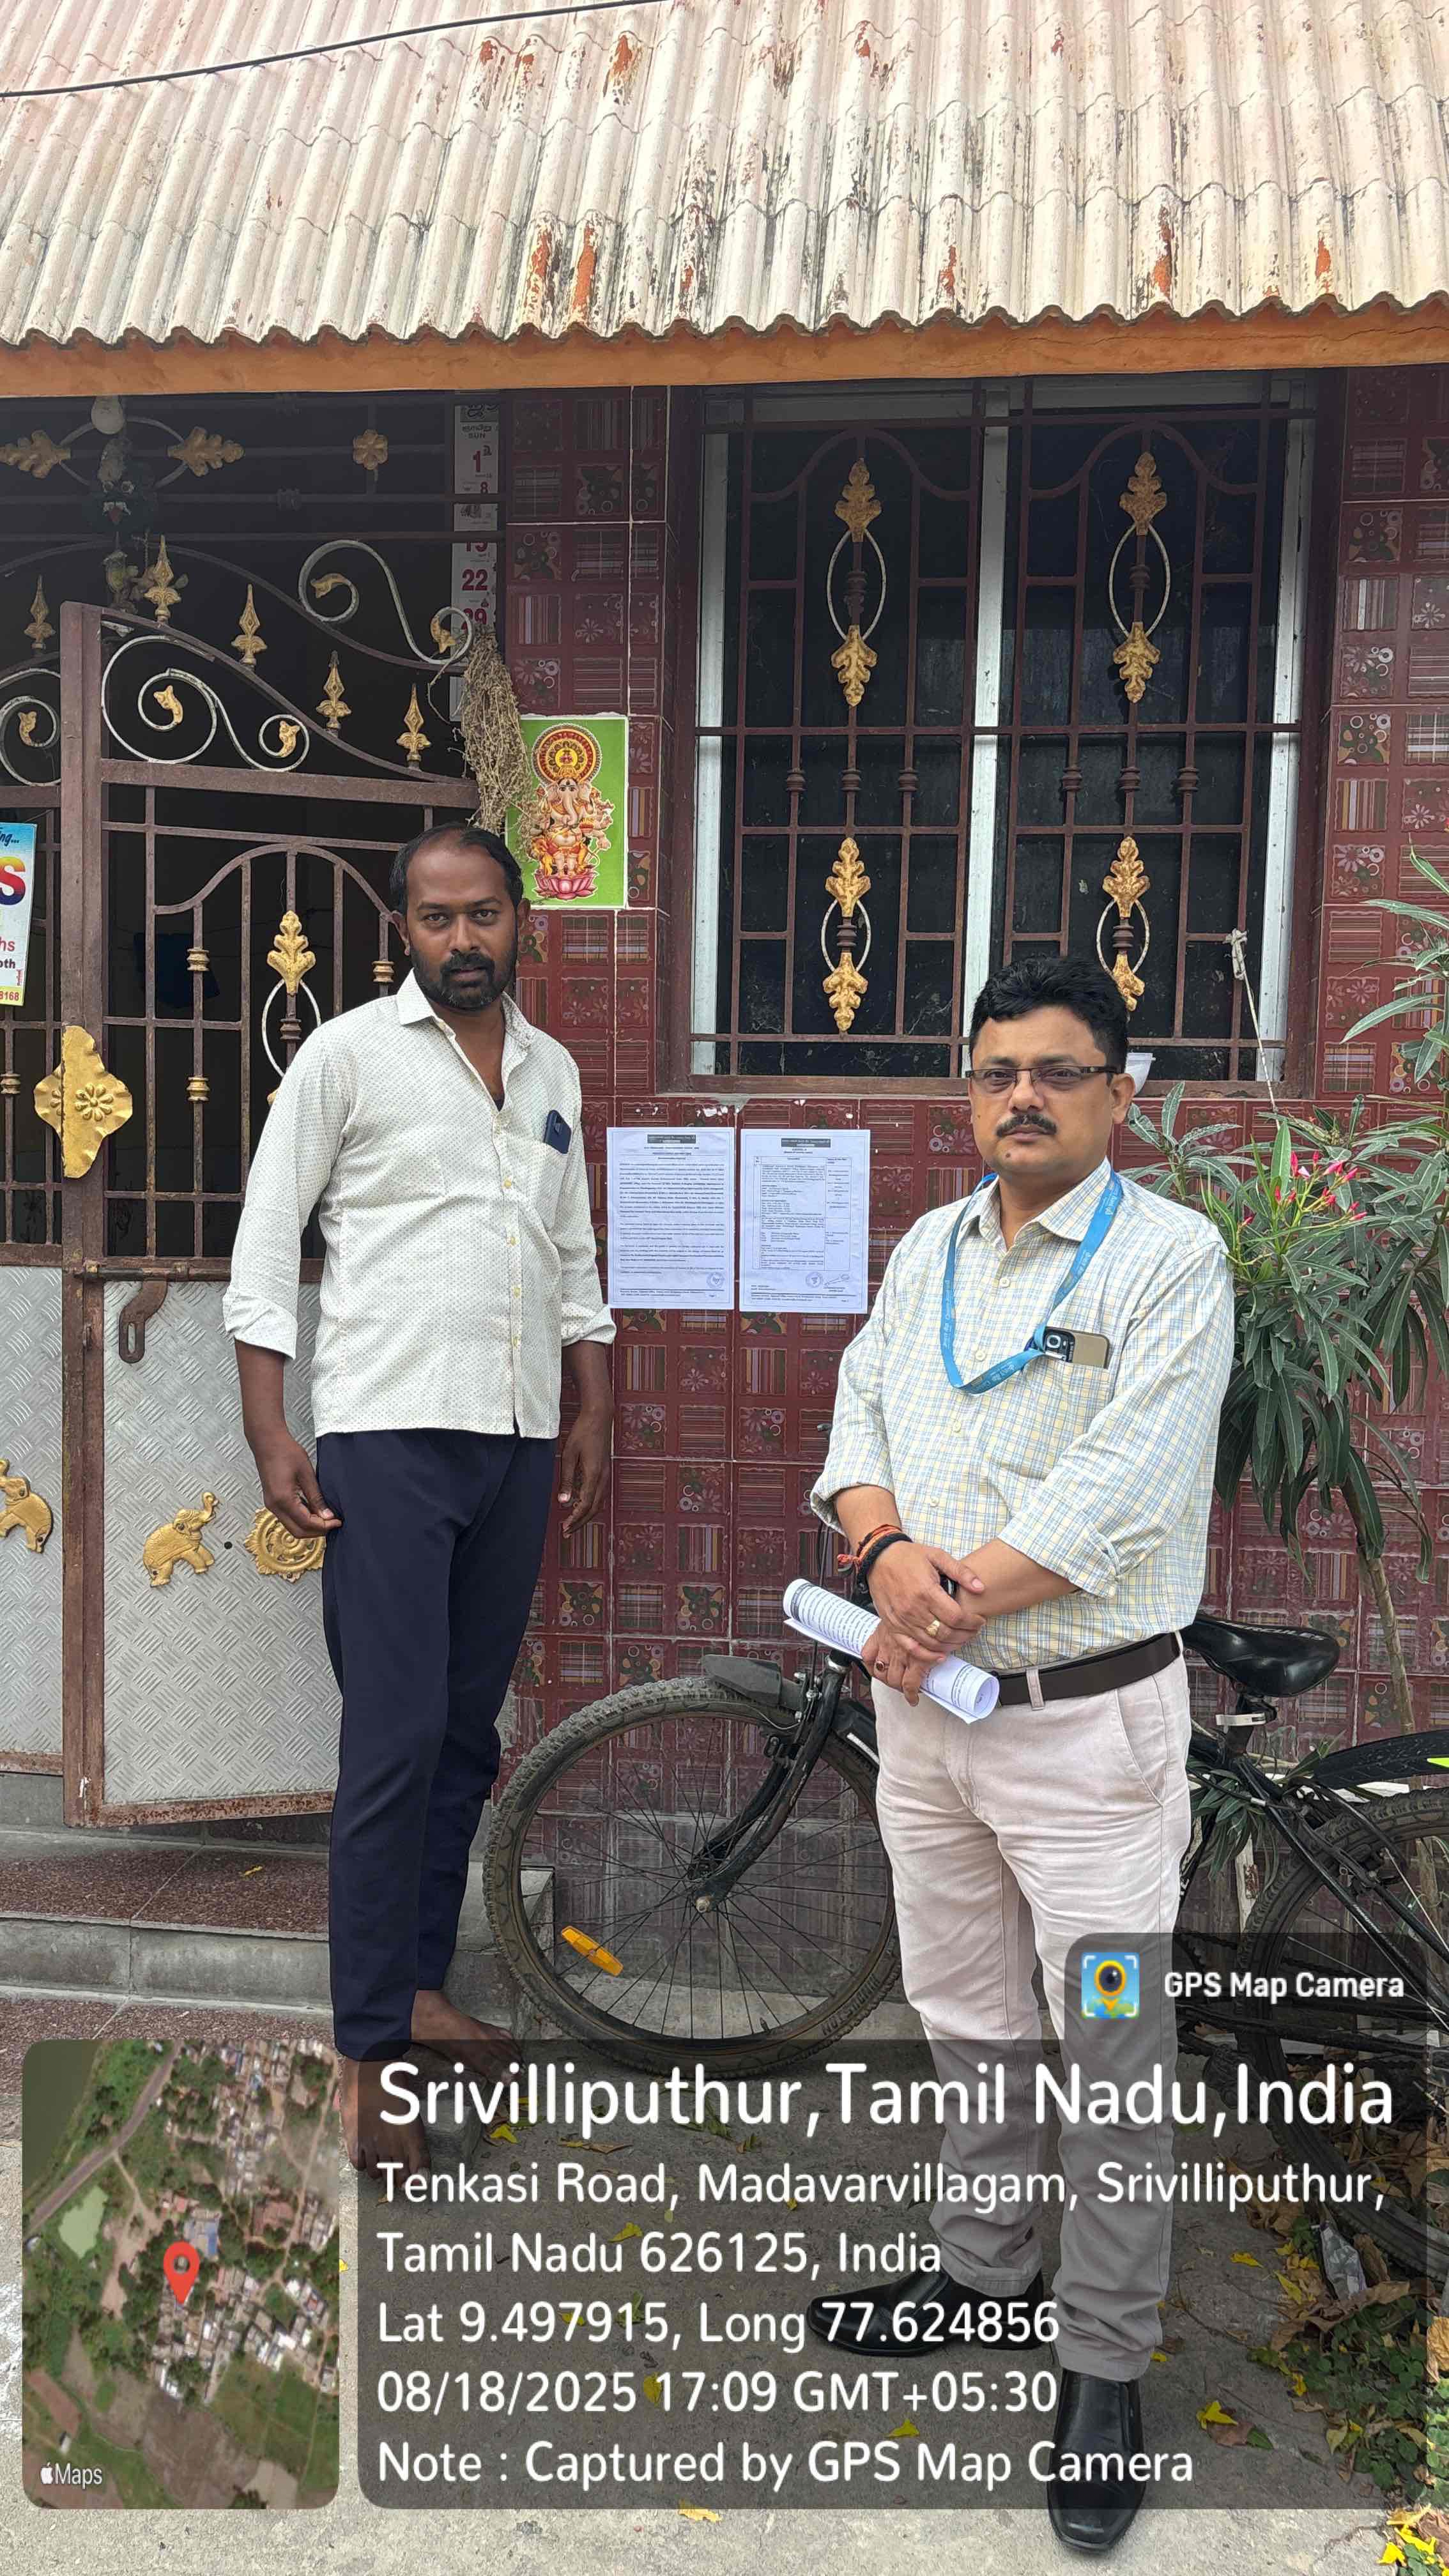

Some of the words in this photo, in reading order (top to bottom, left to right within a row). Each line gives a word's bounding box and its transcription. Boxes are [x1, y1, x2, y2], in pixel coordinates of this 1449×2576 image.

[473, 450, 480, 472] 1
[480, 482, 488, 494] 8
[462, 569, 488, 591] 22
[0, 857, 26, 905] S
